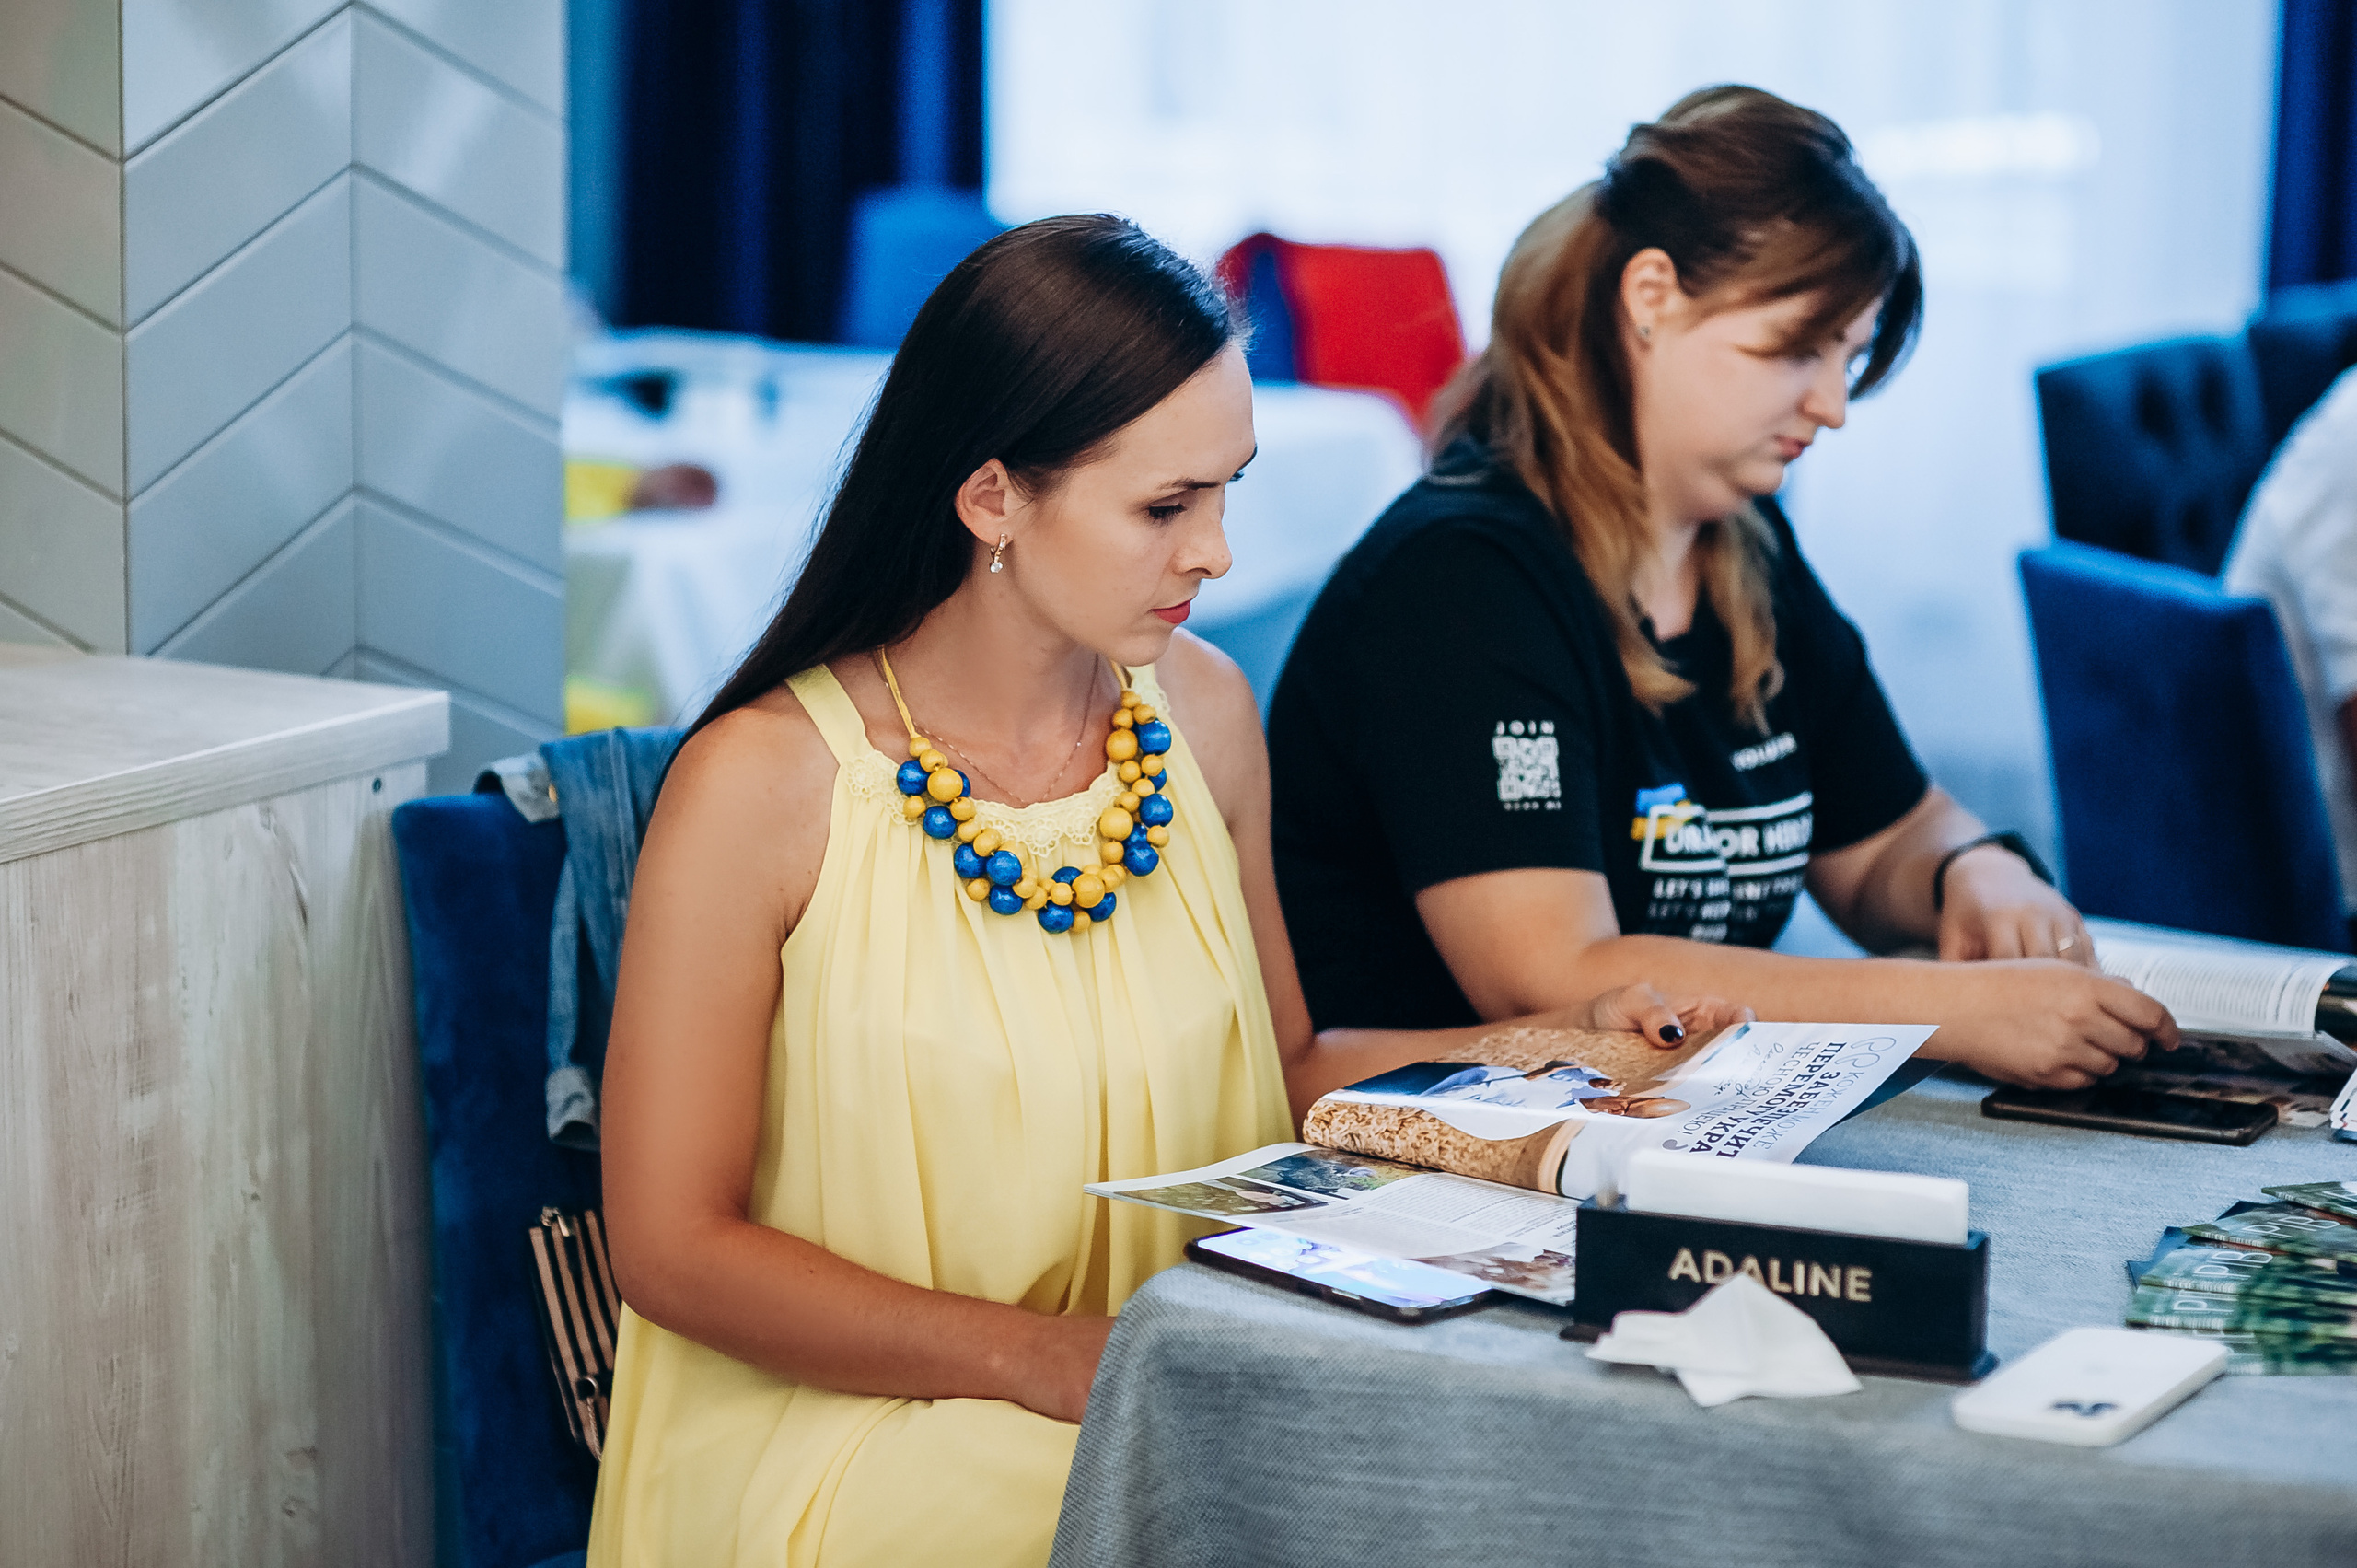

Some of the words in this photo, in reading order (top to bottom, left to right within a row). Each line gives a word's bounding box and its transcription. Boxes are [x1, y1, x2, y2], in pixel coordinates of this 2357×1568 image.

[1746, 1041, 1847, 1116] ПЕРЕМОГУ
[1751, 1041, 1820, 1097] ЧЕСНОЮ
[1805, 1071, 1864, 1116] КОЖЕН
[1689, 1115, 1744, 1153] УКРА
[1715, 1071, 1841, 1158] ЗАБЕЗПЕЧИТ
[1667, 1247, 1873, 1302] ADALINE
